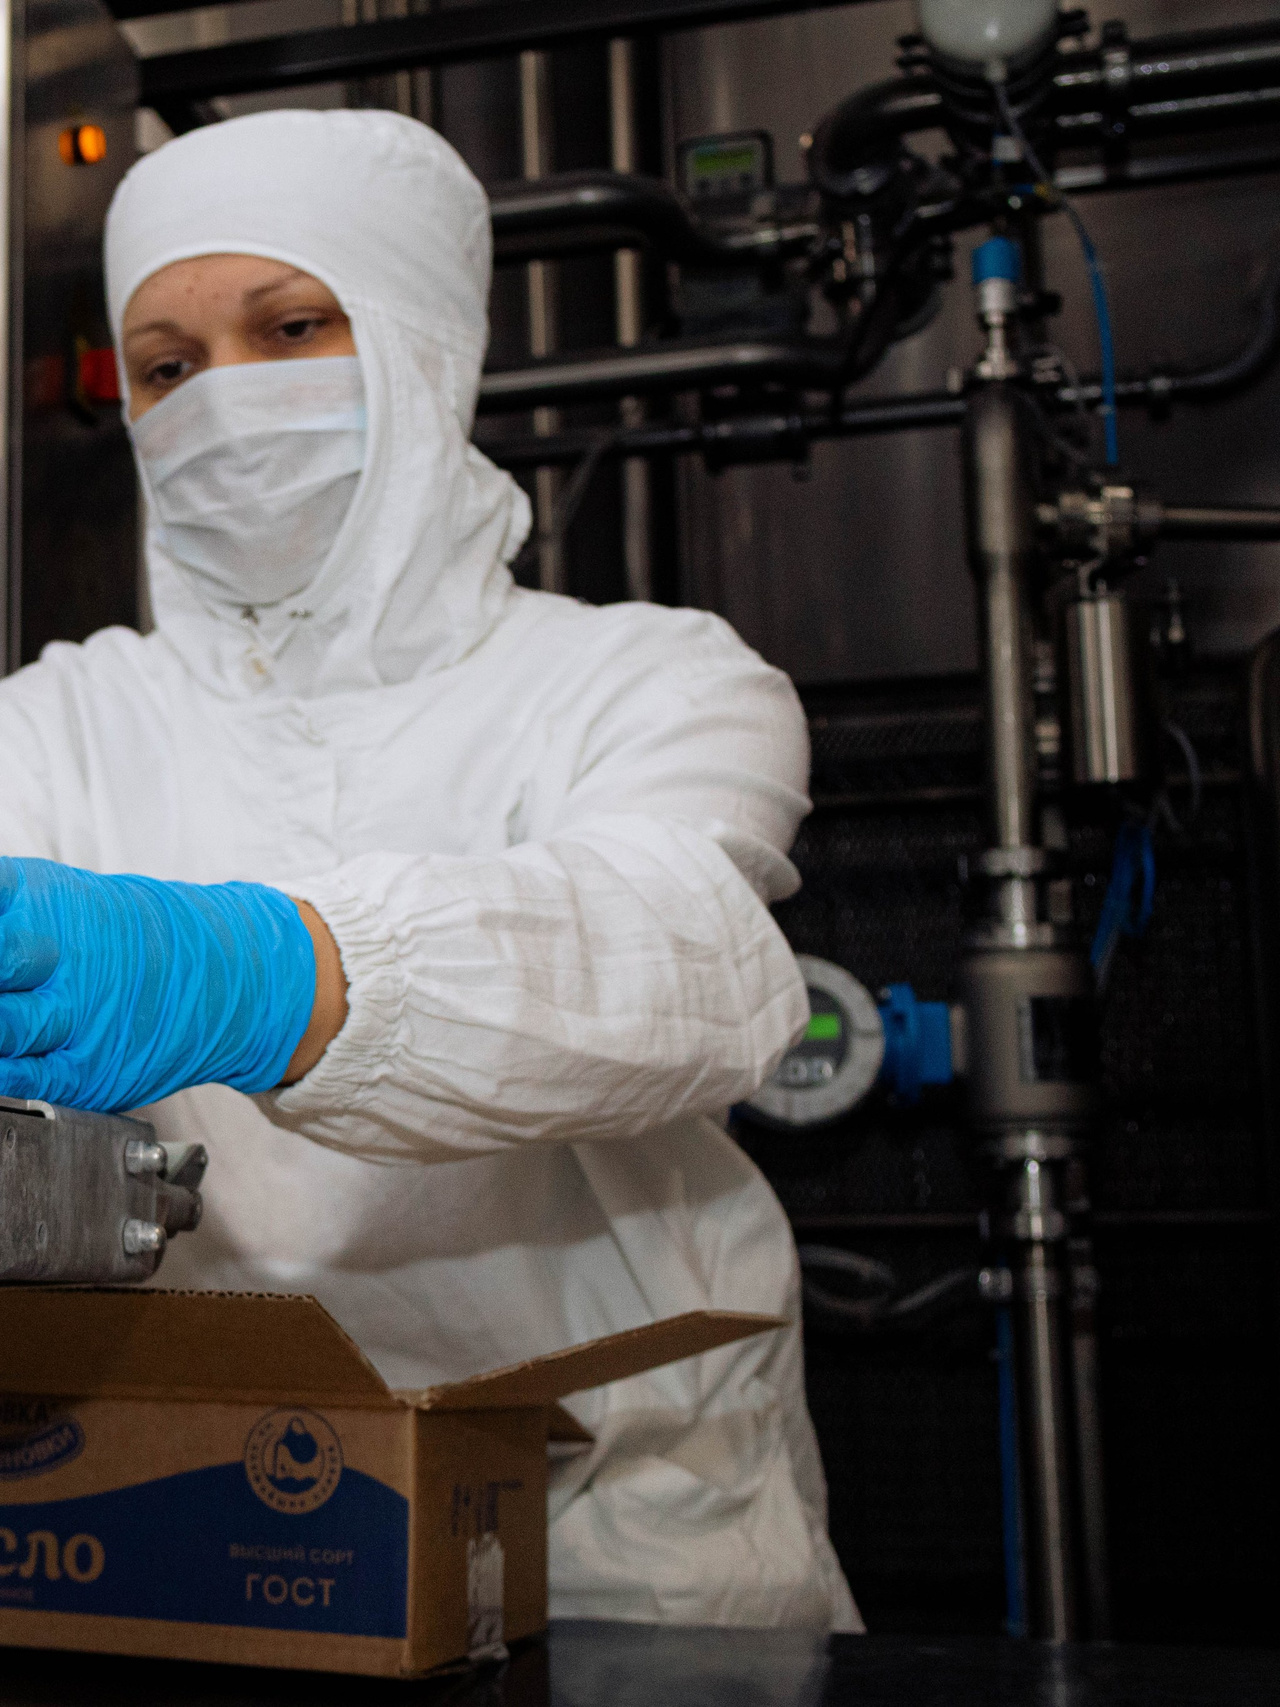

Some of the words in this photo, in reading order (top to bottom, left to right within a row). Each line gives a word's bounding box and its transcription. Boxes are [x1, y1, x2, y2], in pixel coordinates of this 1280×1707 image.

[228, 1542, 306, 1563] ВЫСШИЙ
[309, 1547, 355, 1566] СОРТ
[244, 1571, 336, 1608] ГОСТ
